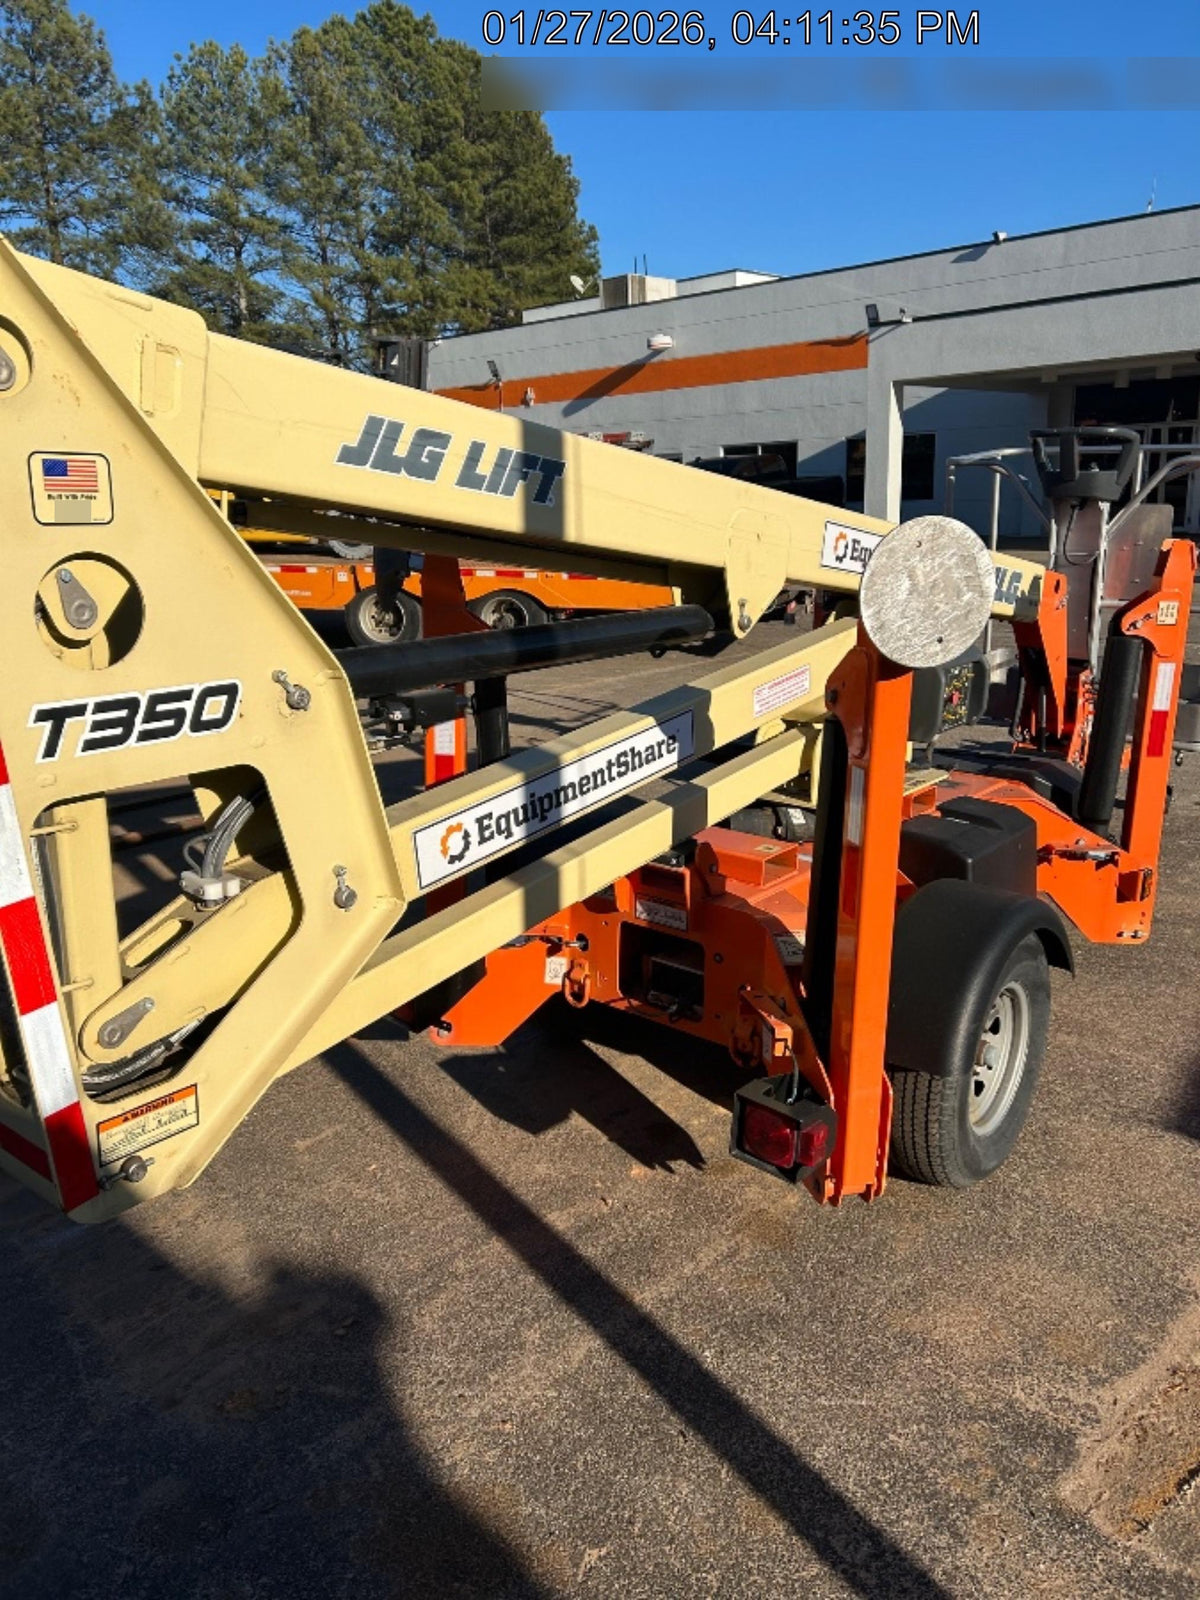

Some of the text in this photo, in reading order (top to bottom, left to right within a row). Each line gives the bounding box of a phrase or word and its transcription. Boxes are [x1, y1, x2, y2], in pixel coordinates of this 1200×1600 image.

[335, 414, 566, 505] JLG LIFT
[32, 680, 241, 760] T350
[474, 733, 678, 845] EquipmentShare
[131, 1096, 175, 1119] WARNING
